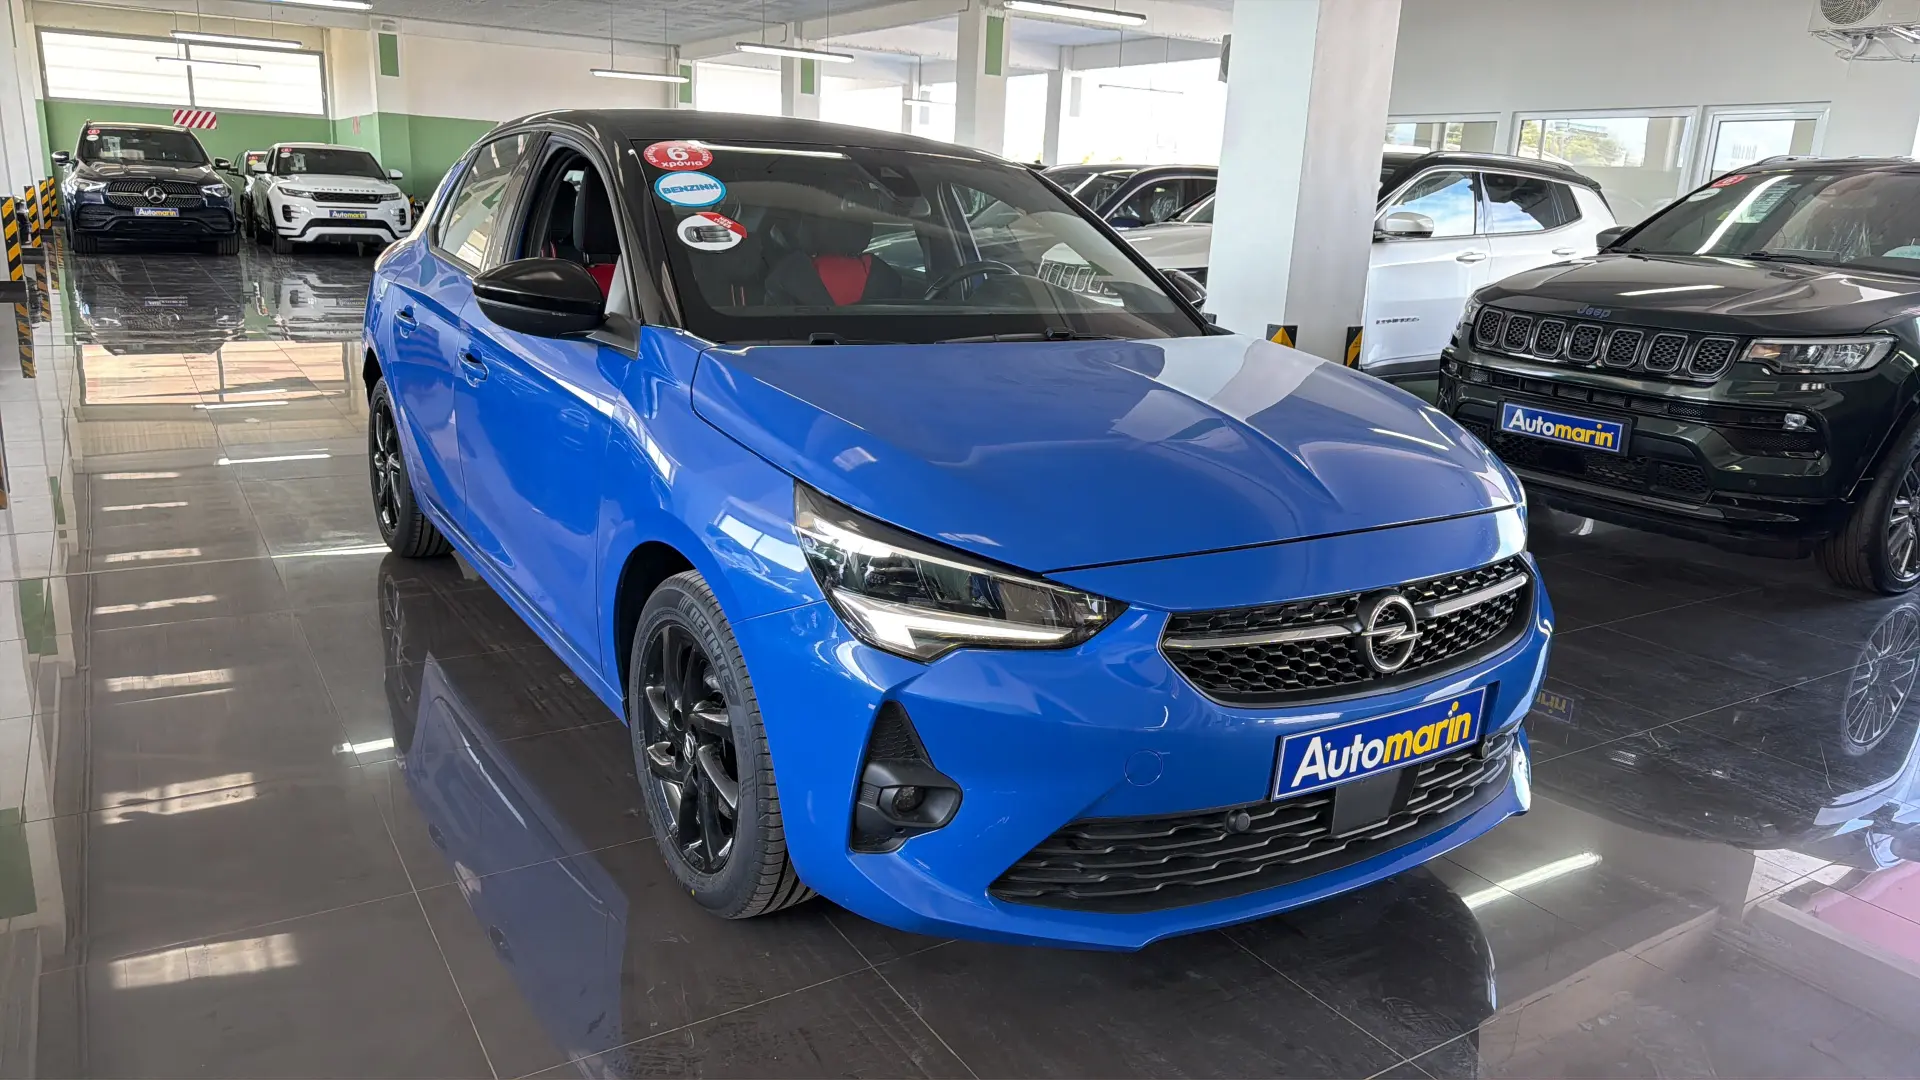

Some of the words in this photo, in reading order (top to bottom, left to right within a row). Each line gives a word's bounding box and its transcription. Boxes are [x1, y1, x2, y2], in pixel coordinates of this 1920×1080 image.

[667, 147, 689, 161] 6
[660, 160, 703, 168] χρόνια
[138, 207, 177, 217] Automarin
[332, 210, 366, 219] Automarin
[1576, 304, 1612, 318] Jeep
[1508, 408, 1613, 447] Automarin
[1290, 701, 1472, 788] Automarin
